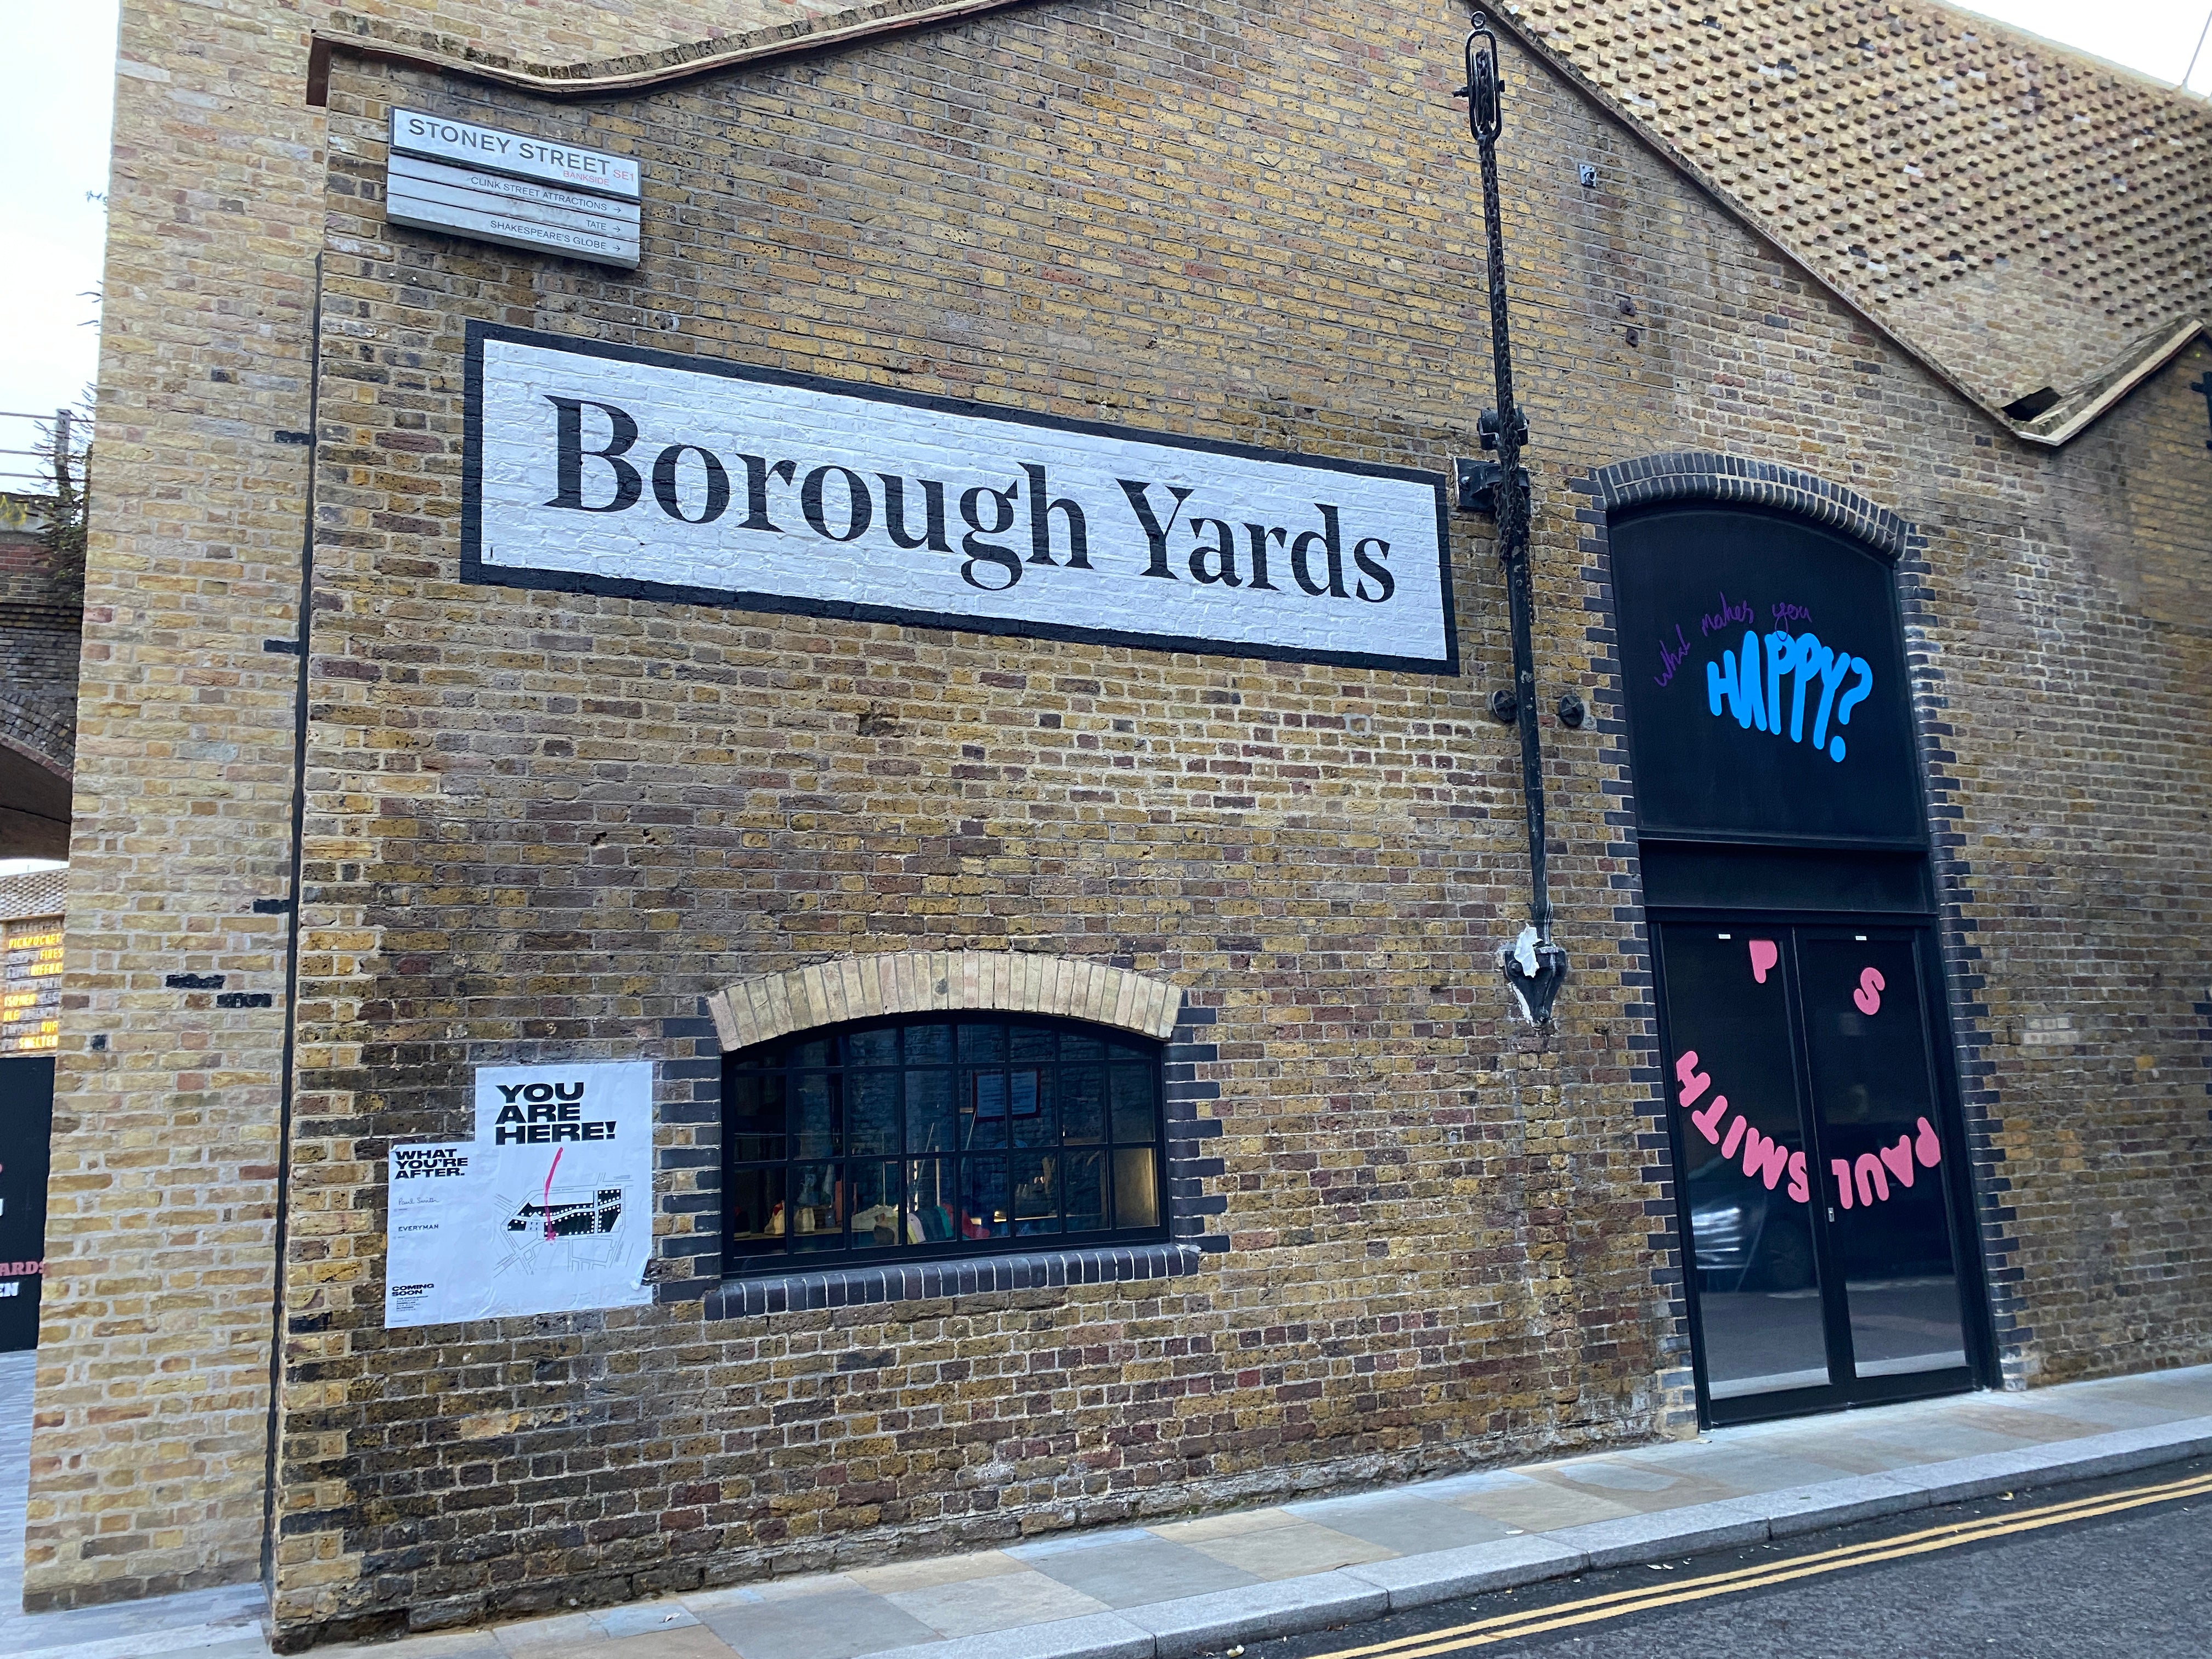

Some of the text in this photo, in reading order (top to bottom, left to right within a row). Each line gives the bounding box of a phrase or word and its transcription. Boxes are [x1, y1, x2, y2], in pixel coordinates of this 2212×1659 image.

[408, 119, 634, 182] STONEY STREET SE1
[563, 171, 610, 185] BANKSIDE
[471, 177, 607, 211] CLINK STREET ATTRACTIONS
[490, 221, 606, 250] SHAKESPEARE'S GLOBE
[586, 220, 607, 230] TATE
[542, 394, 1395, 603] Borough Yards
[1654, 624, 1690, 687] what
[1772, 602, 1812, 641] you
[1707, 630, 1873, 763] HAPPY?
[1749, 940, 1885, 1015] P S
[495, 1082, 584, 1103] YOU
[495, 1102, 580, 1124] ARE
[495, 1121, 617, 1146] HERE!
[1675, 1050, 1942, 1209] PAUL SMITH
[395, 1149, 457, 1160] WHAT
[395, 1158, 468, 1169] YOU'RE
[394, 1167, 465, 1180] AFTER.
